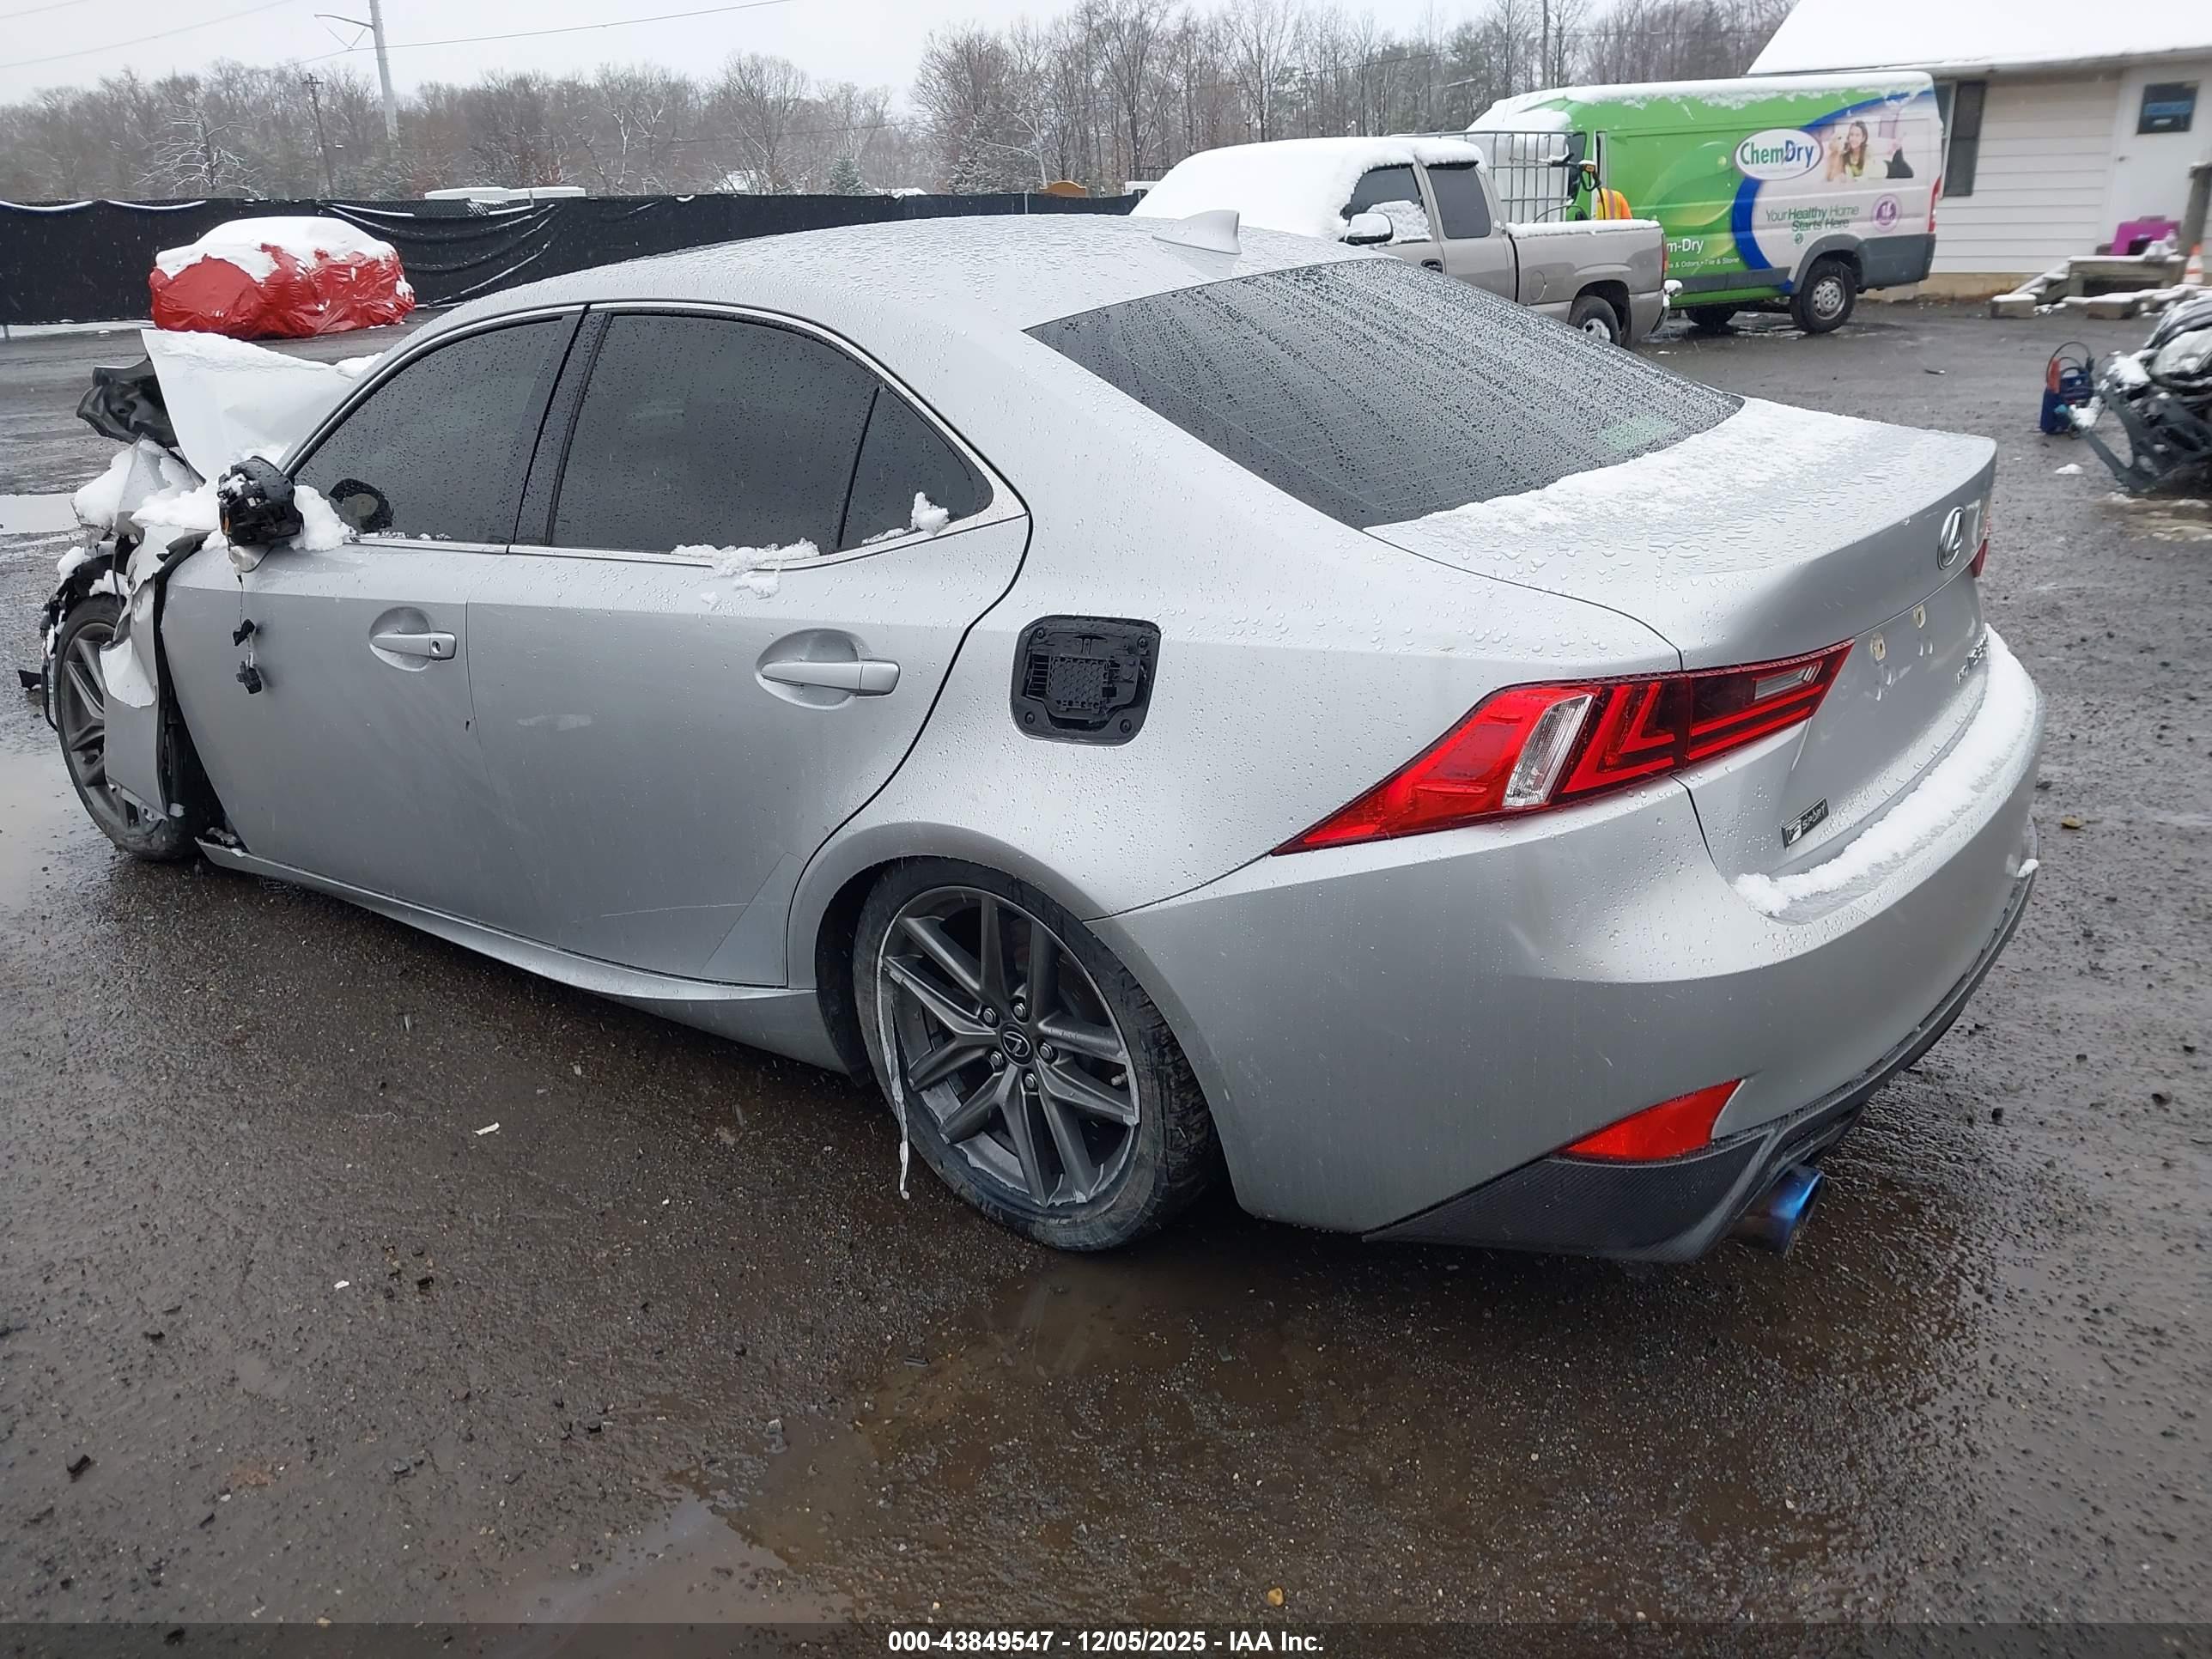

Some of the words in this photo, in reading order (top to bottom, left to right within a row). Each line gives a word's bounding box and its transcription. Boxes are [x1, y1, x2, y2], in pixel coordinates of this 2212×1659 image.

[1765, 209, 1788, 222] Your
[1788, 206, 1827, 220] Healthy
[1830, 204, 1859, 216] Home
[1792, 220, 1821, 232] Starts
[1826, 218, 1850, 228] Here
[1667, 238, 1704, 254] m-Dry
[1802, 800, 1826, 830] SPORT
